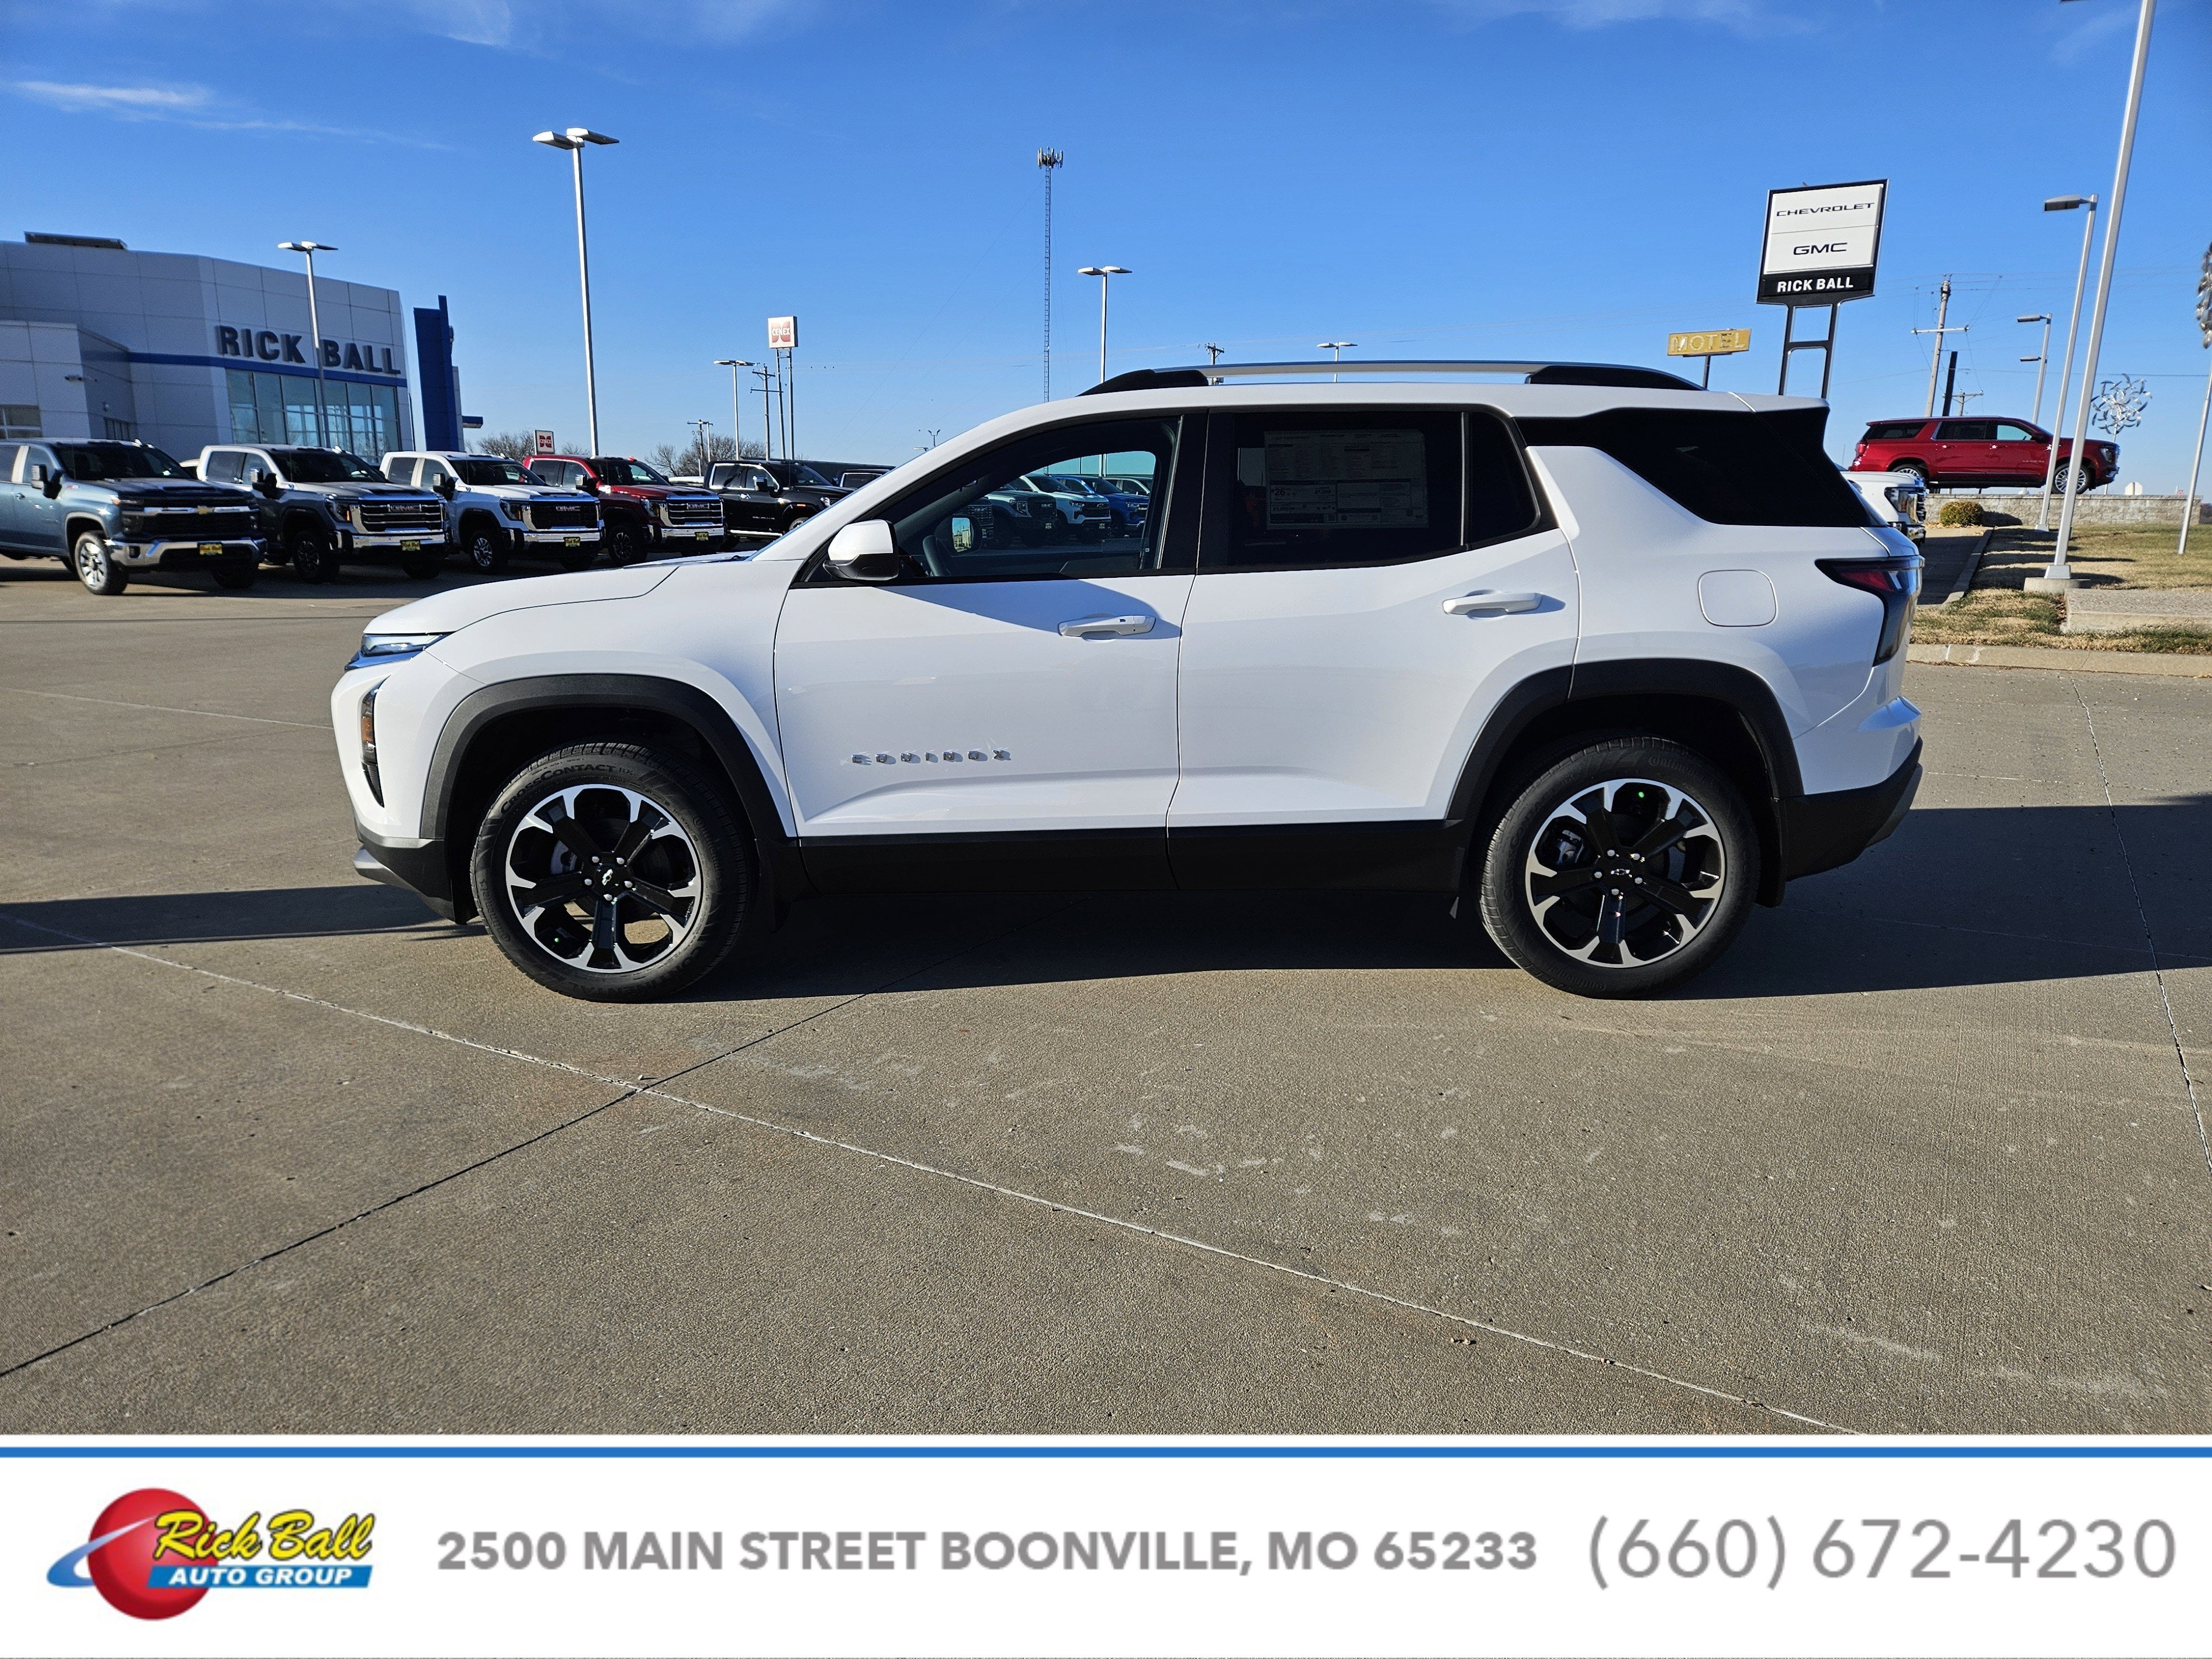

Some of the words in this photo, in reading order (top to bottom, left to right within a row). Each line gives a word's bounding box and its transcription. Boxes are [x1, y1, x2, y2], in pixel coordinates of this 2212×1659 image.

[1776, 202, 1875, 216] CHEVROLET
[1793, 242, 1848, 255] GMC
[1777, 278, 1813, 293] RICK
[1816, 276, 1854, 290] BALL
[215, 325, 306, 364] RICK
[319, 338, 401, 375] BALL
[1670, 332, 1745, 352] MOTEL
[852, 749, 1004, 764] EQUINOX
